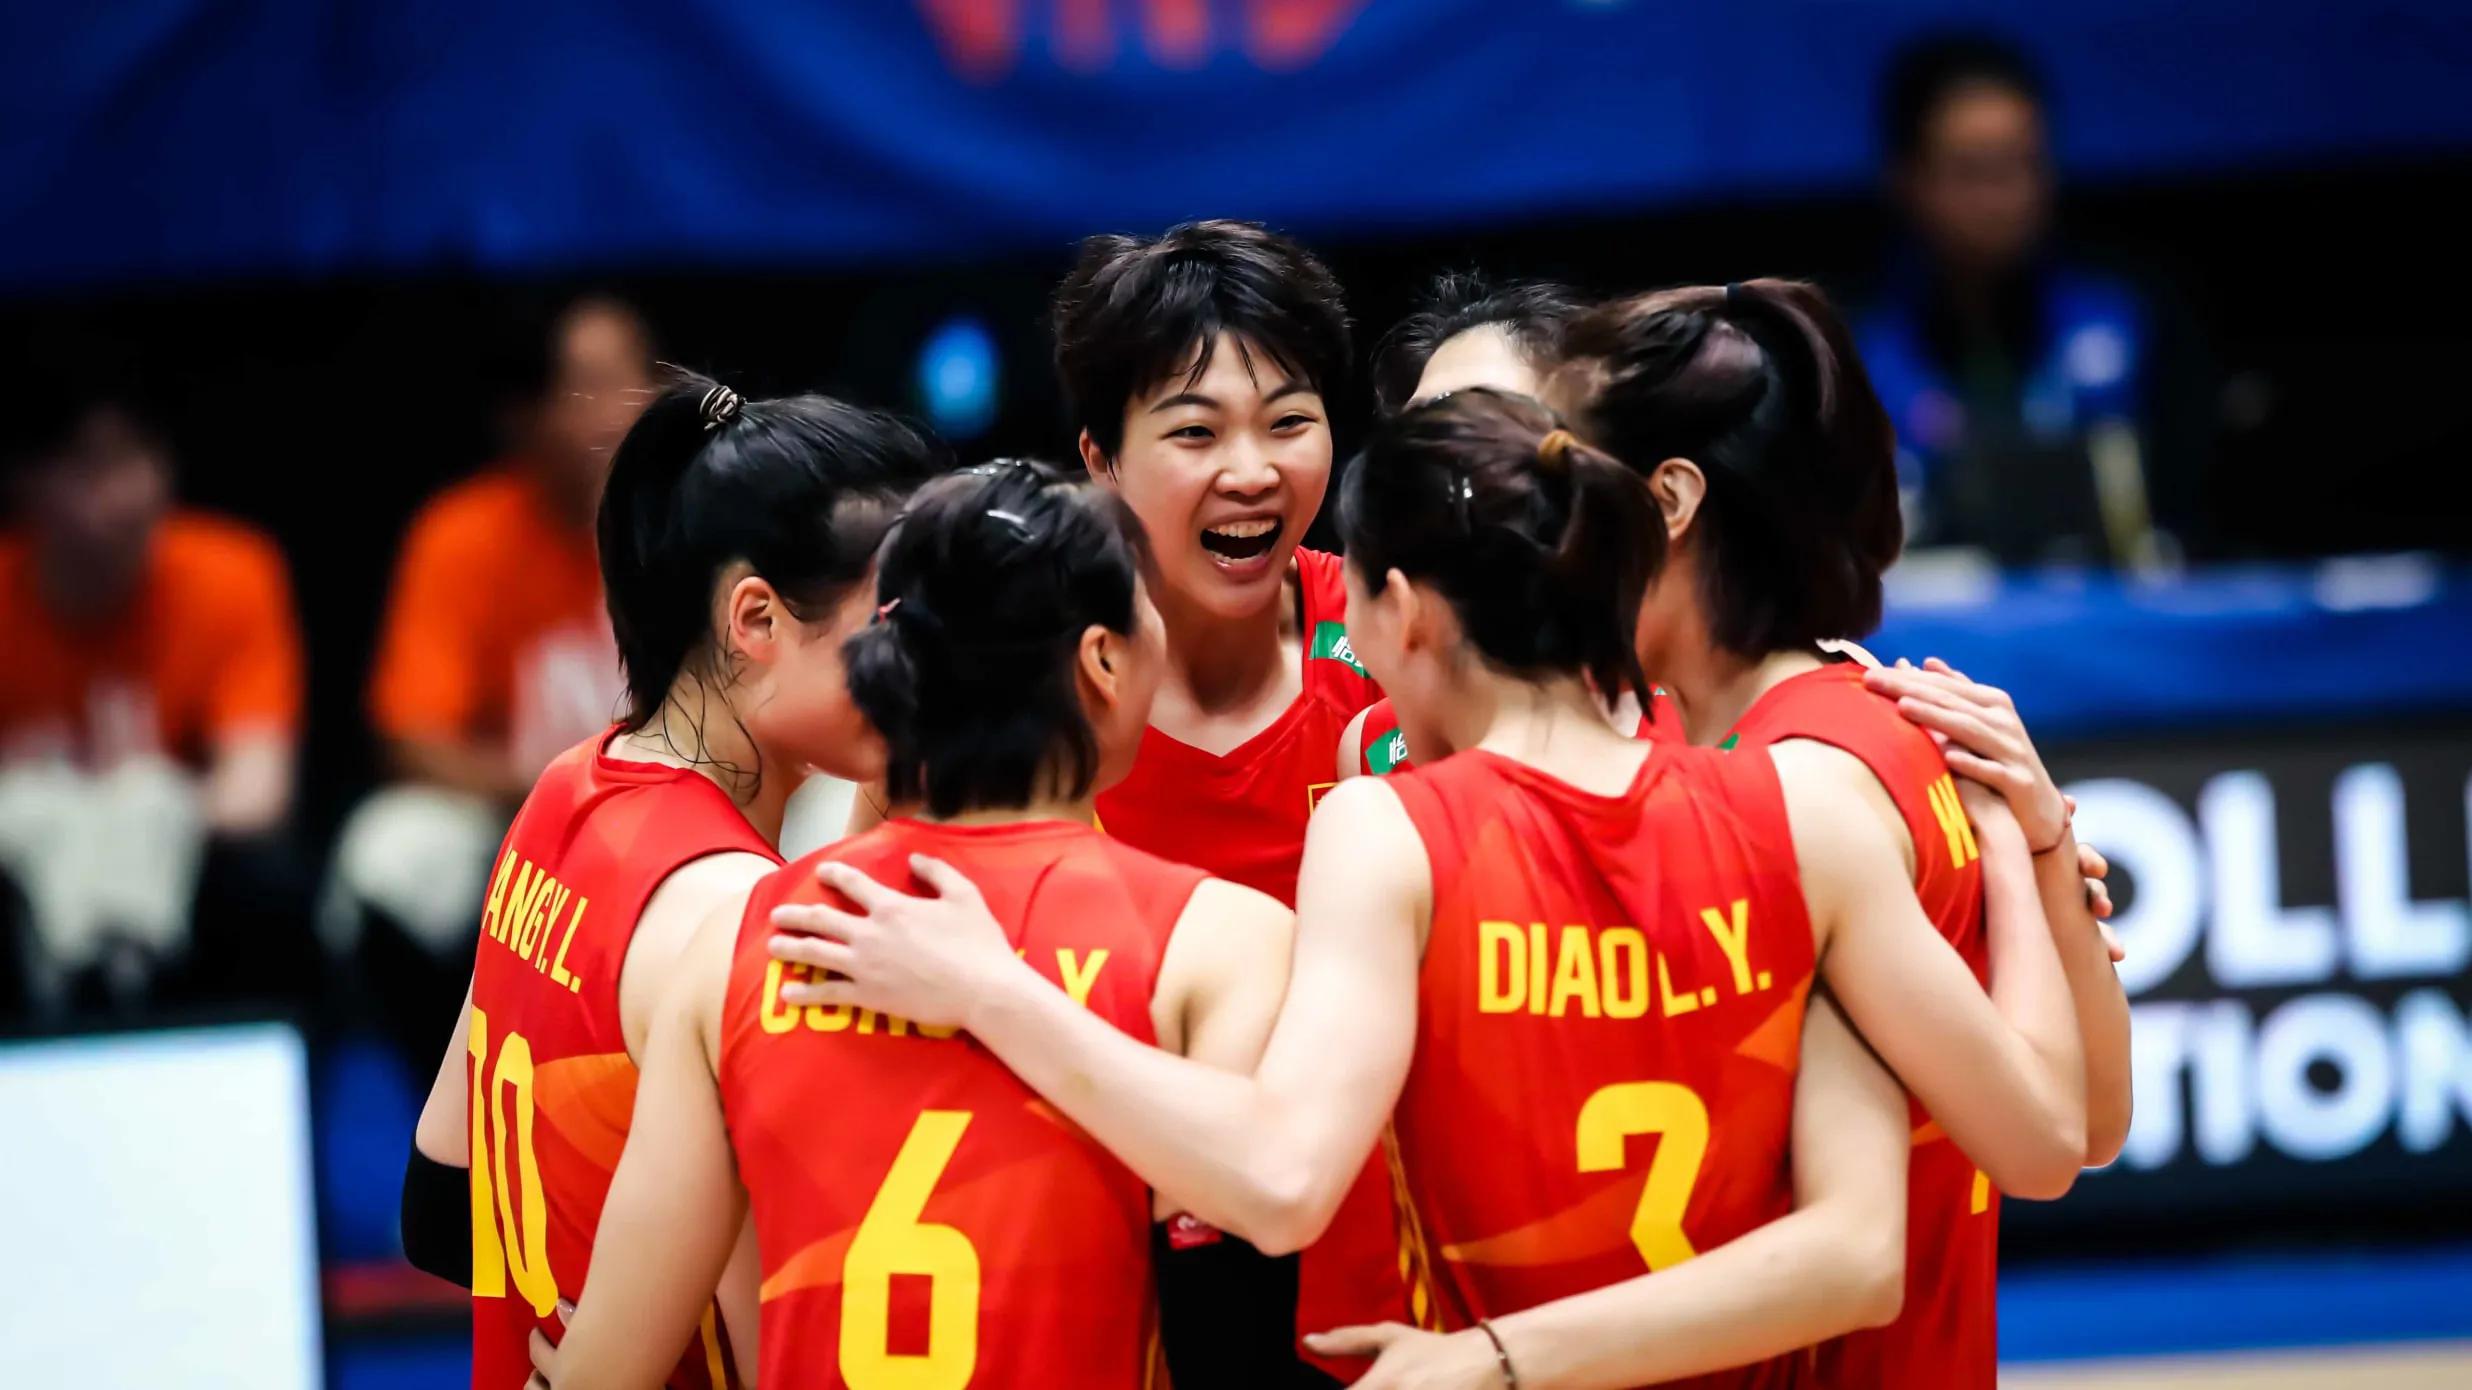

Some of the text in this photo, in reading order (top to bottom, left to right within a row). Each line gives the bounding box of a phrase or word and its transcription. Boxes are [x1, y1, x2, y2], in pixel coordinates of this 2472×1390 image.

[550, 896, 589, 994] L.
[1479, 920, 1650, 1019] DIAO
[1700, 898, 1772, 996] Y.
[2060, 762, 2472, 998] OLL
[467, 1004, 559, 1318] 10
[838, 1110, 981, 1390] 6
